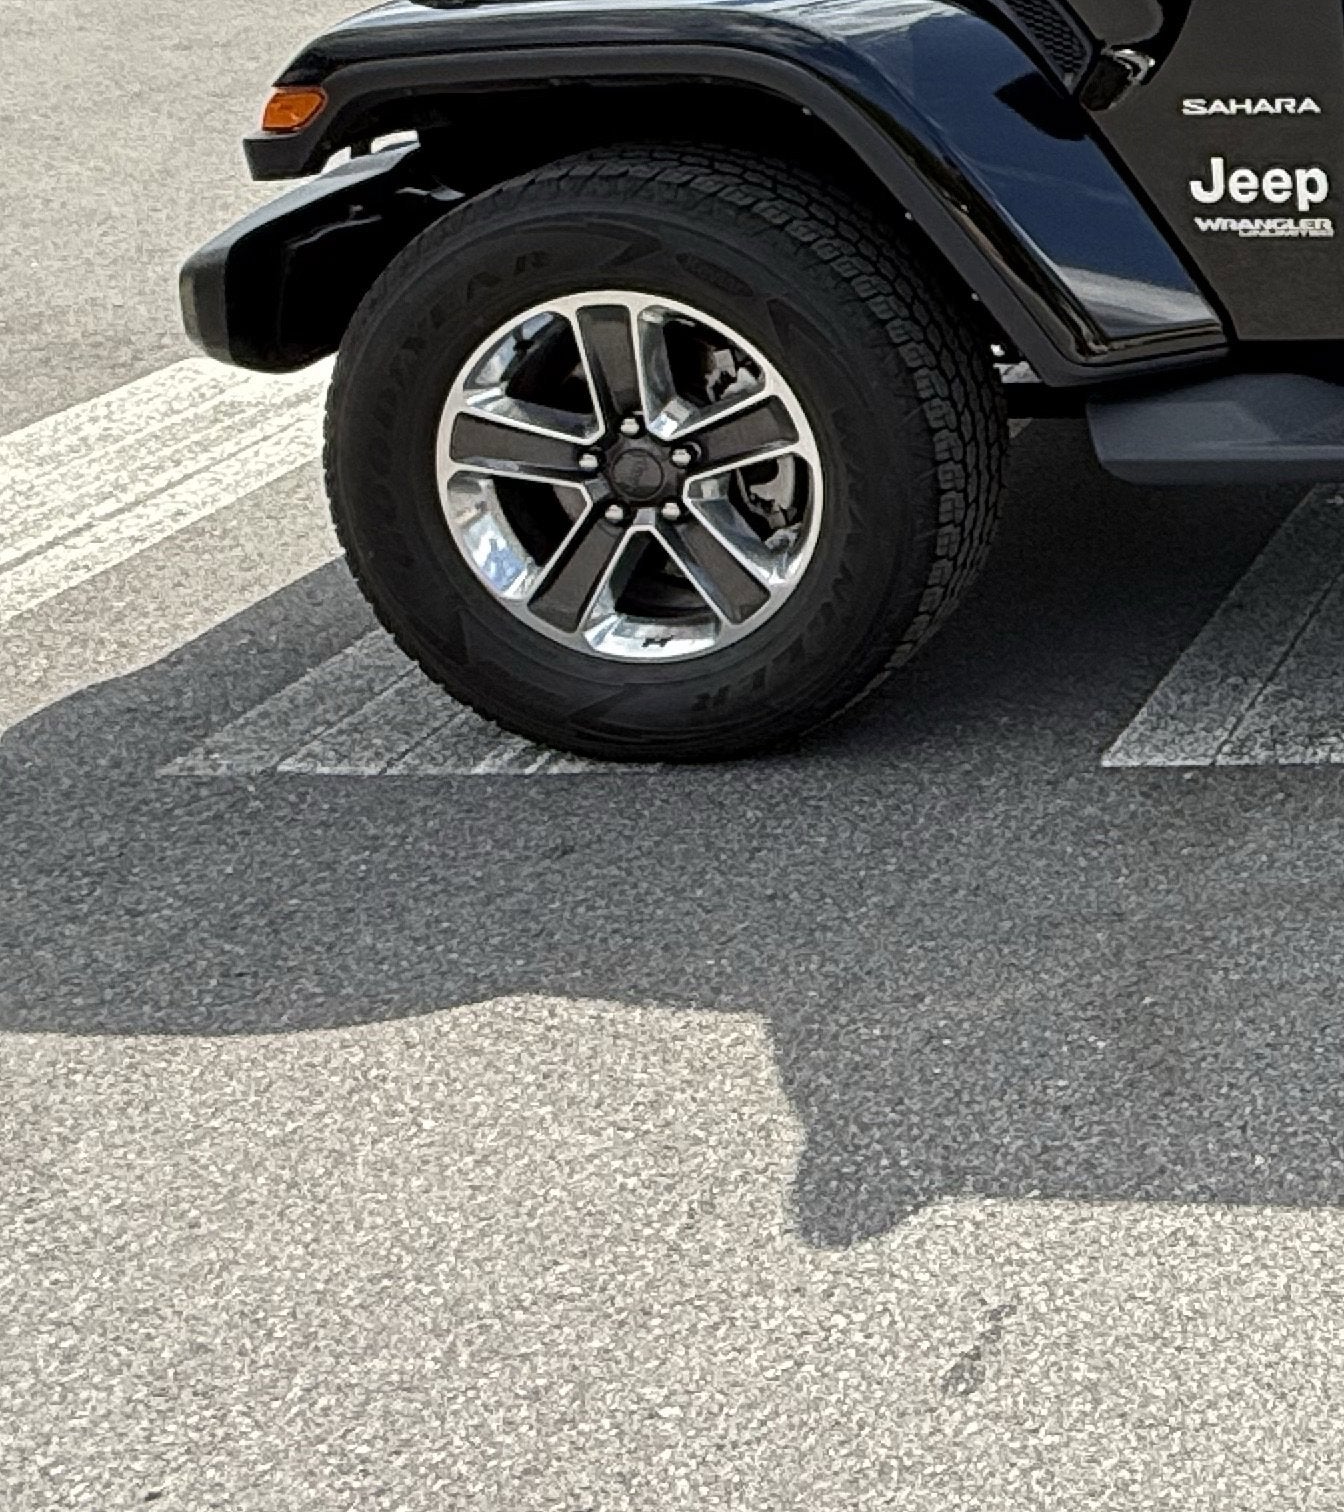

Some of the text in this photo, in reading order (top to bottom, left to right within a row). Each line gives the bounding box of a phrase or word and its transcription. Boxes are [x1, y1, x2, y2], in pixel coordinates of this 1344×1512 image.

[1182, 97, 1322, 115] SAHARA
[1189, 156, 1329, 212] Jeep
[1193, 216, 1333, 231] WRANGLER
